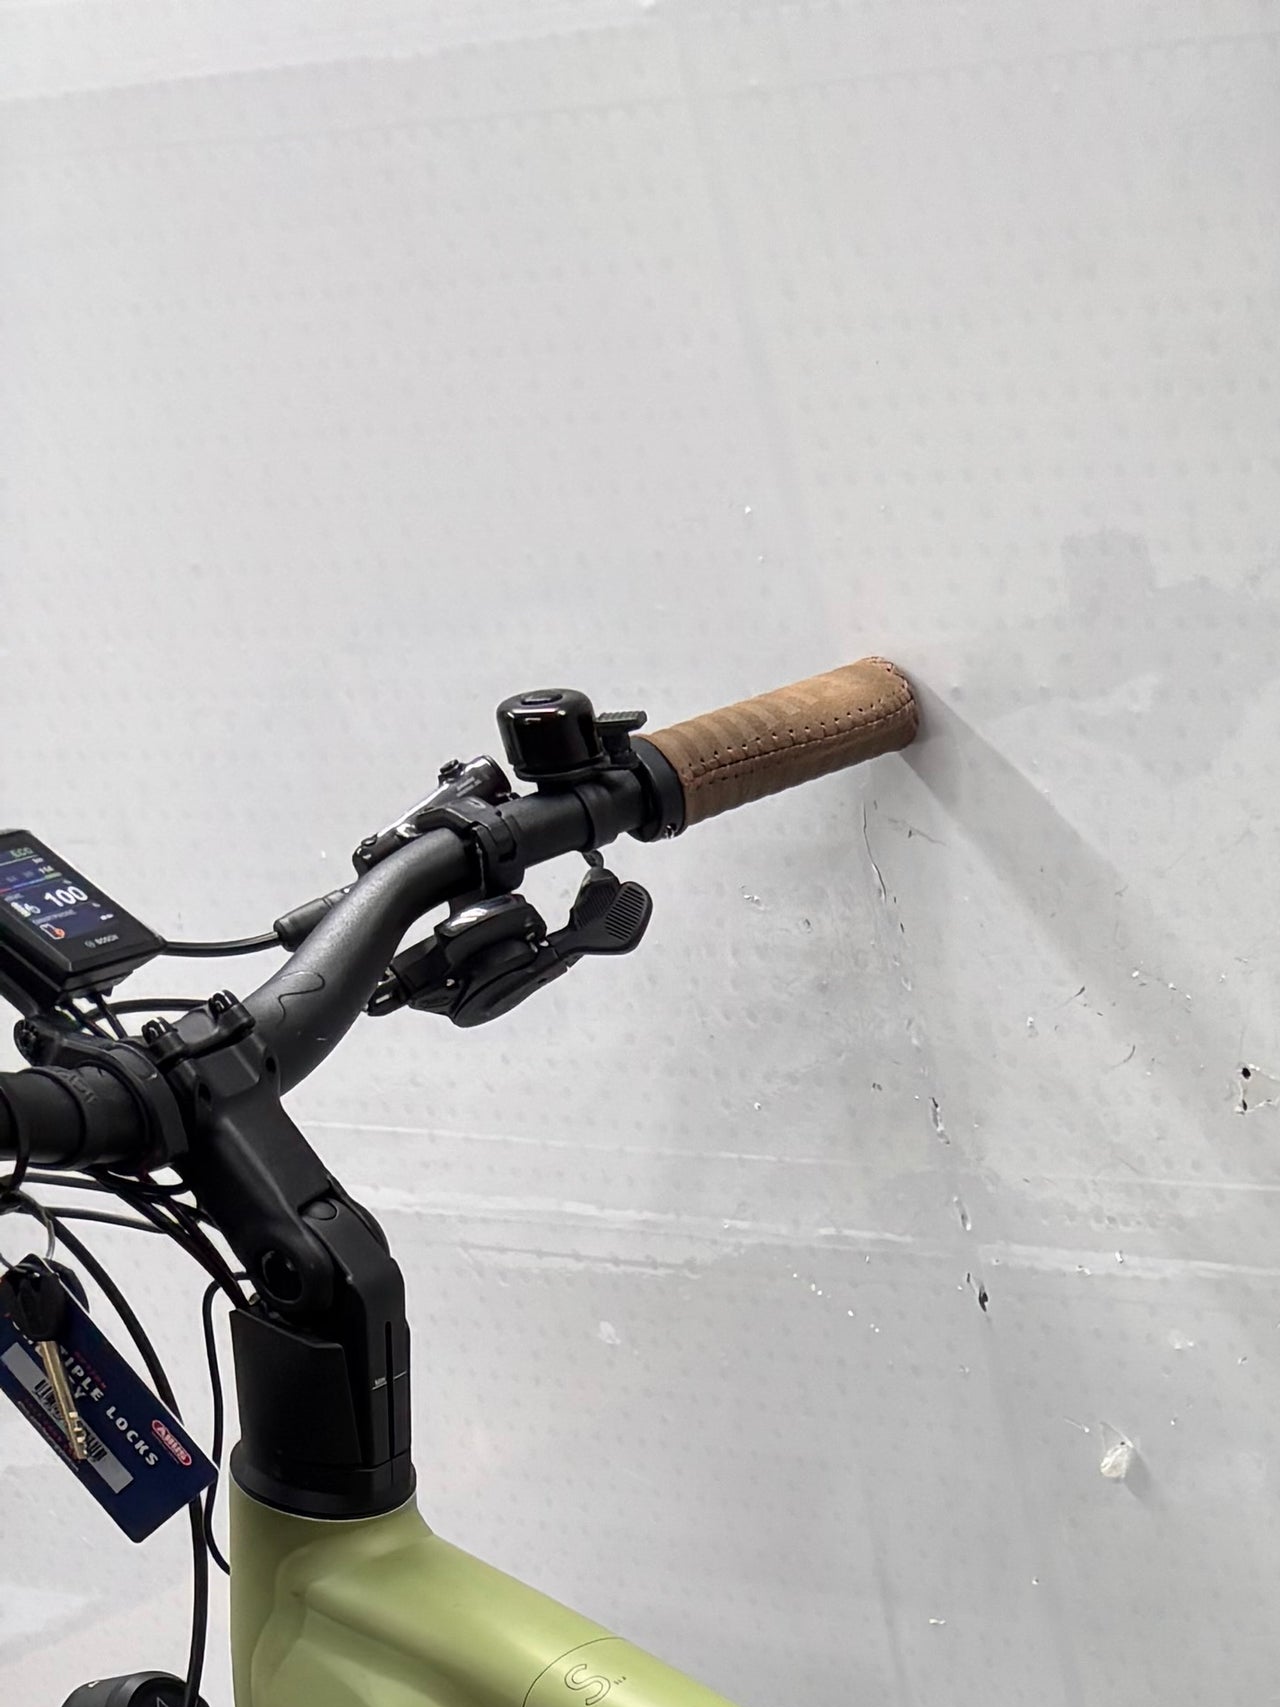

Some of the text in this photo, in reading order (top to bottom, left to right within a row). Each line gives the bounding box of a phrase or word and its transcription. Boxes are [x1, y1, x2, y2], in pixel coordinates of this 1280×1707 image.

[44, 885, 89, 907] 100
[105, 1406, 158, 1466] LOCKS
[564, 1663, 612, 1706] S
